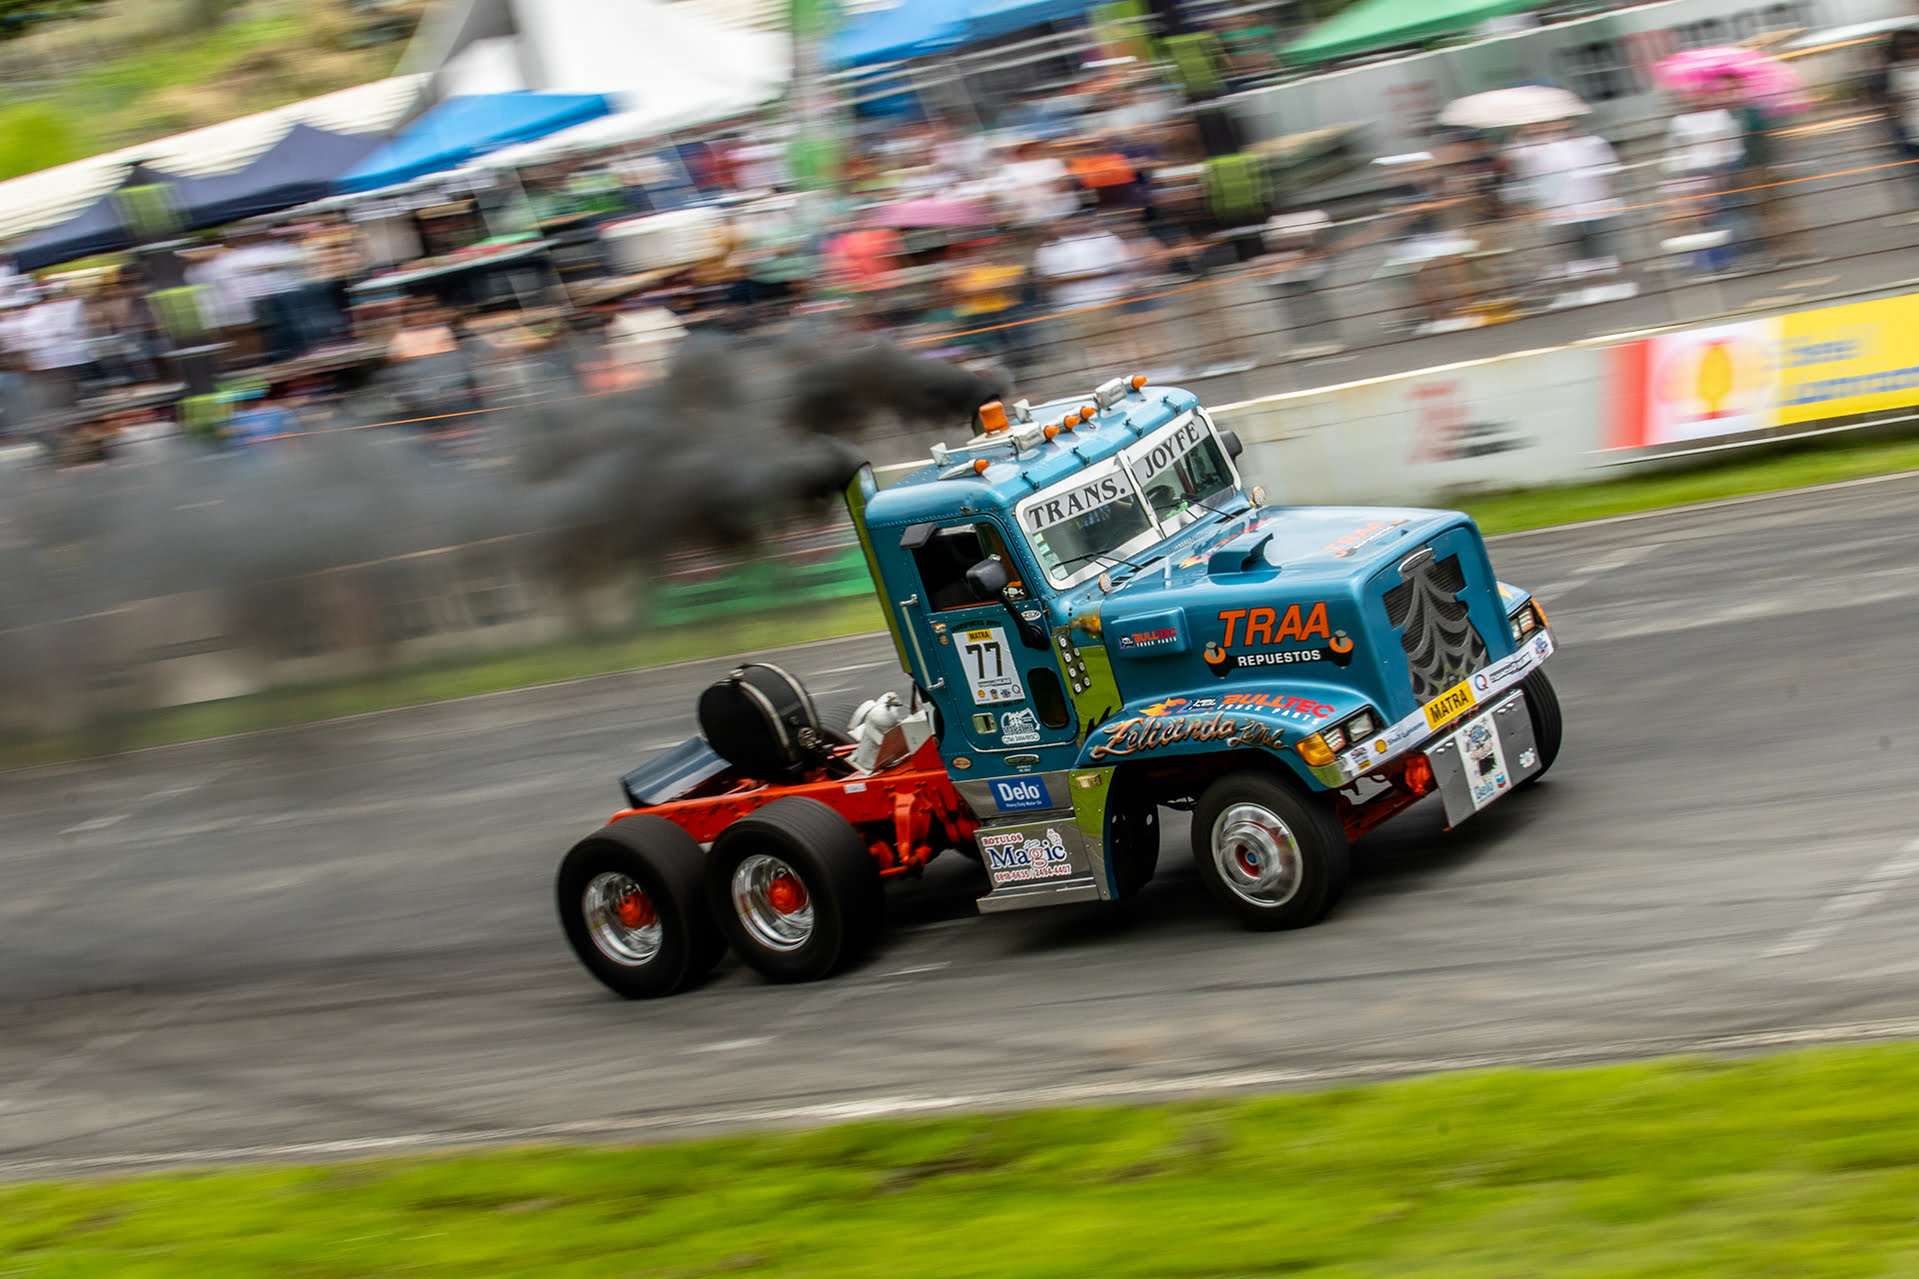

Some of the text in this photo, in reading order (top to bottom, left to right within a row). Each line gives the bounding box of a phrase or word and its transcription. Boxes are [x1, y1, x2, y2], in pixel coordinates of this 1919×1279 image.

[1028, 421, 1200, 530] TRANS. JOYFE
[968, 631, 990, 640] MATRA
[1131, 627, 1177, 643] BULLTEC
[1217, 602, 1332, 649] TRAA
[965, 642, 1003, 679] 77
[1237, 650, 1321, 667] REPUESTOS
[1221, 694, 1335, 719] BULLTEC
[1271, 708, 1322, 726] PARTS
[1429, 689, 1469, 723] MATRA
[997, 781, 1041, 802] Delo
[982, 834, 1022, 845] ROTULOS
[987, 840, 1066, 868] Magic
